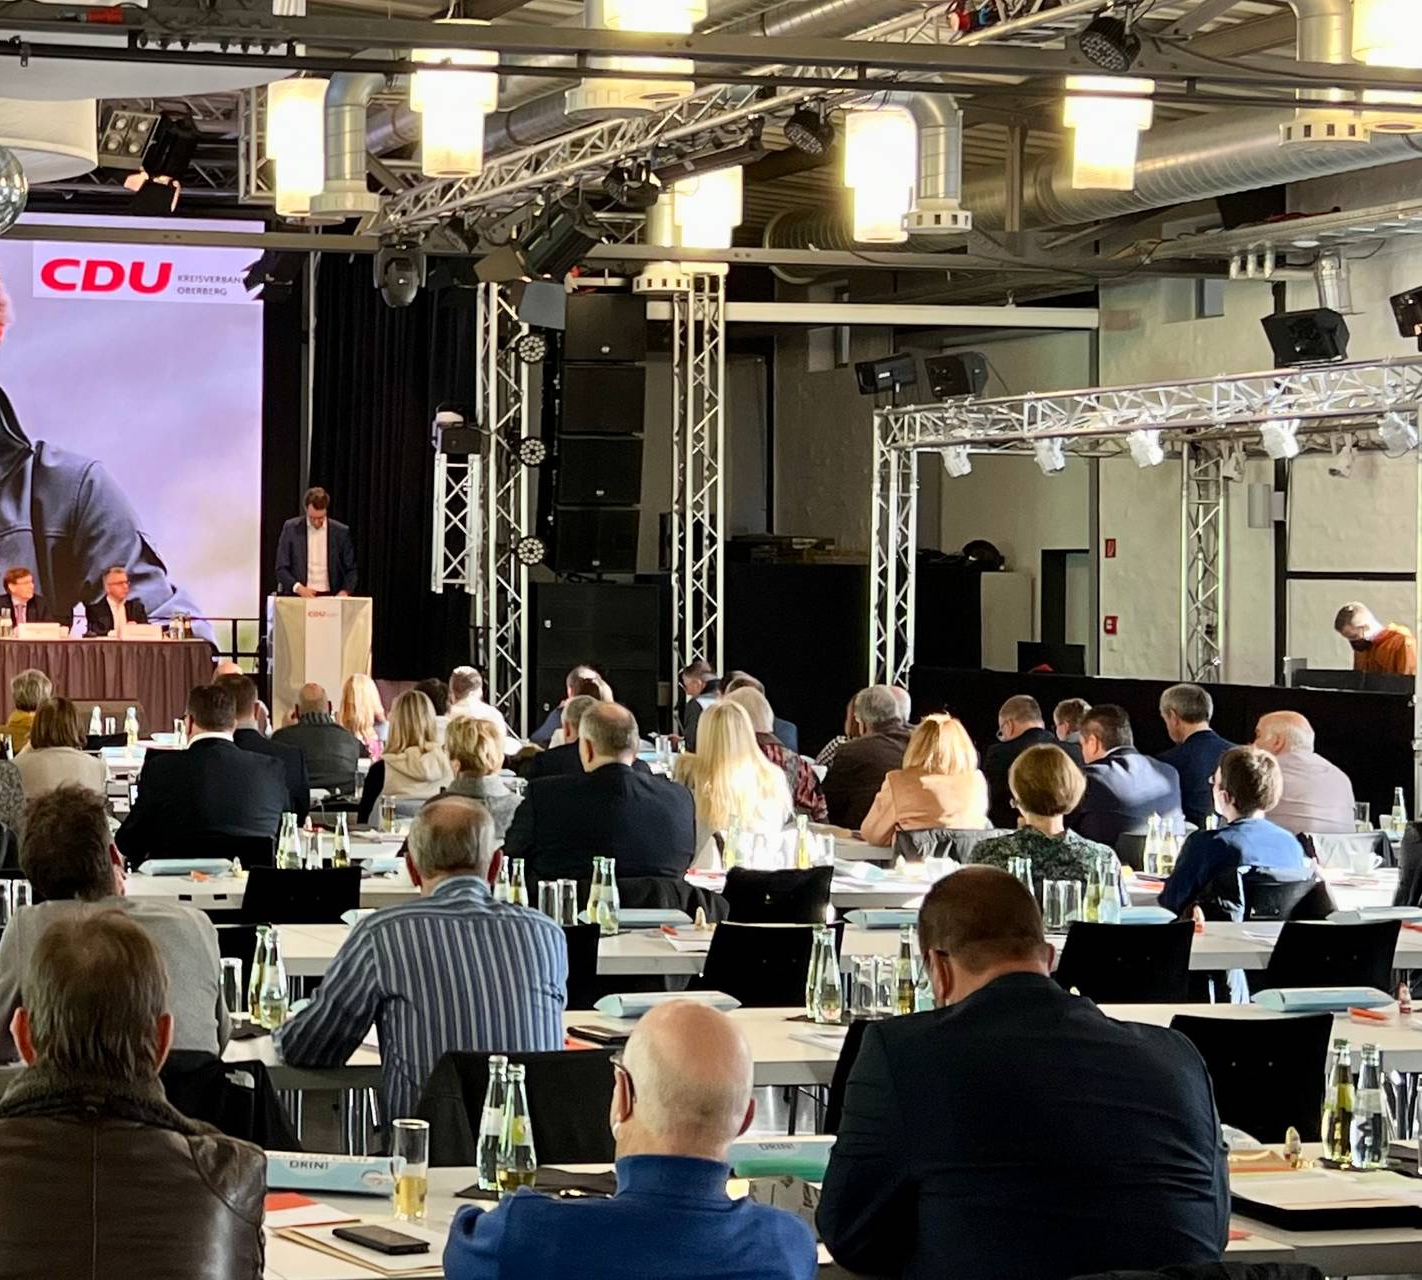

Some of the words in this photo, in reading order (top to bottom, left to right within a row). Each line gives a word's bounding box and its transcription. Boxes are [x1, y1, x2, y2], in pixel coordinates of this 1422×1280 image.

[41, 258, 173, 295] CDU
[177, 275, 242, 284] KREISVERBAN
[177, 286, 228, 296] OBERBERG
[289, 1160, 330, 1171] DRIN!
